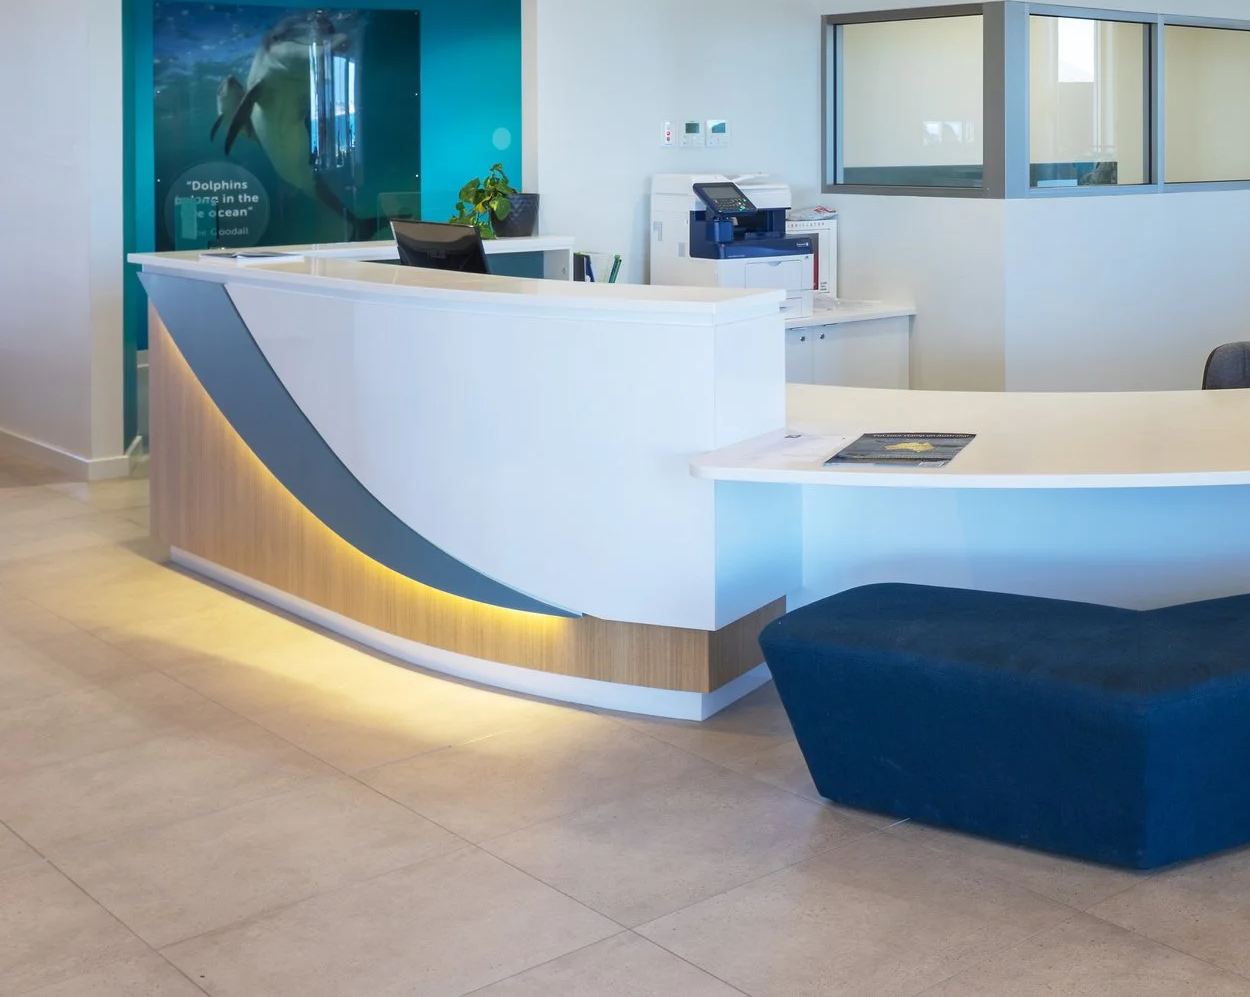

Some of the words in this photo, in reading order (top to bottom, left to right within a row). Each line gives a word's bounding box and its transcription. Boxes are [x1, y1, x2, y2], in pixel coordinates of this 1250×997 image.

[186, 180, 248, 192] "Dolphins
[174, 194, 219, 206] bong
[222, 194, 235, 203] in
[238, 193, 259, 203] the
[208, 206, 254, 218] ocean"
[210, 227, 249, 236] Goodall
